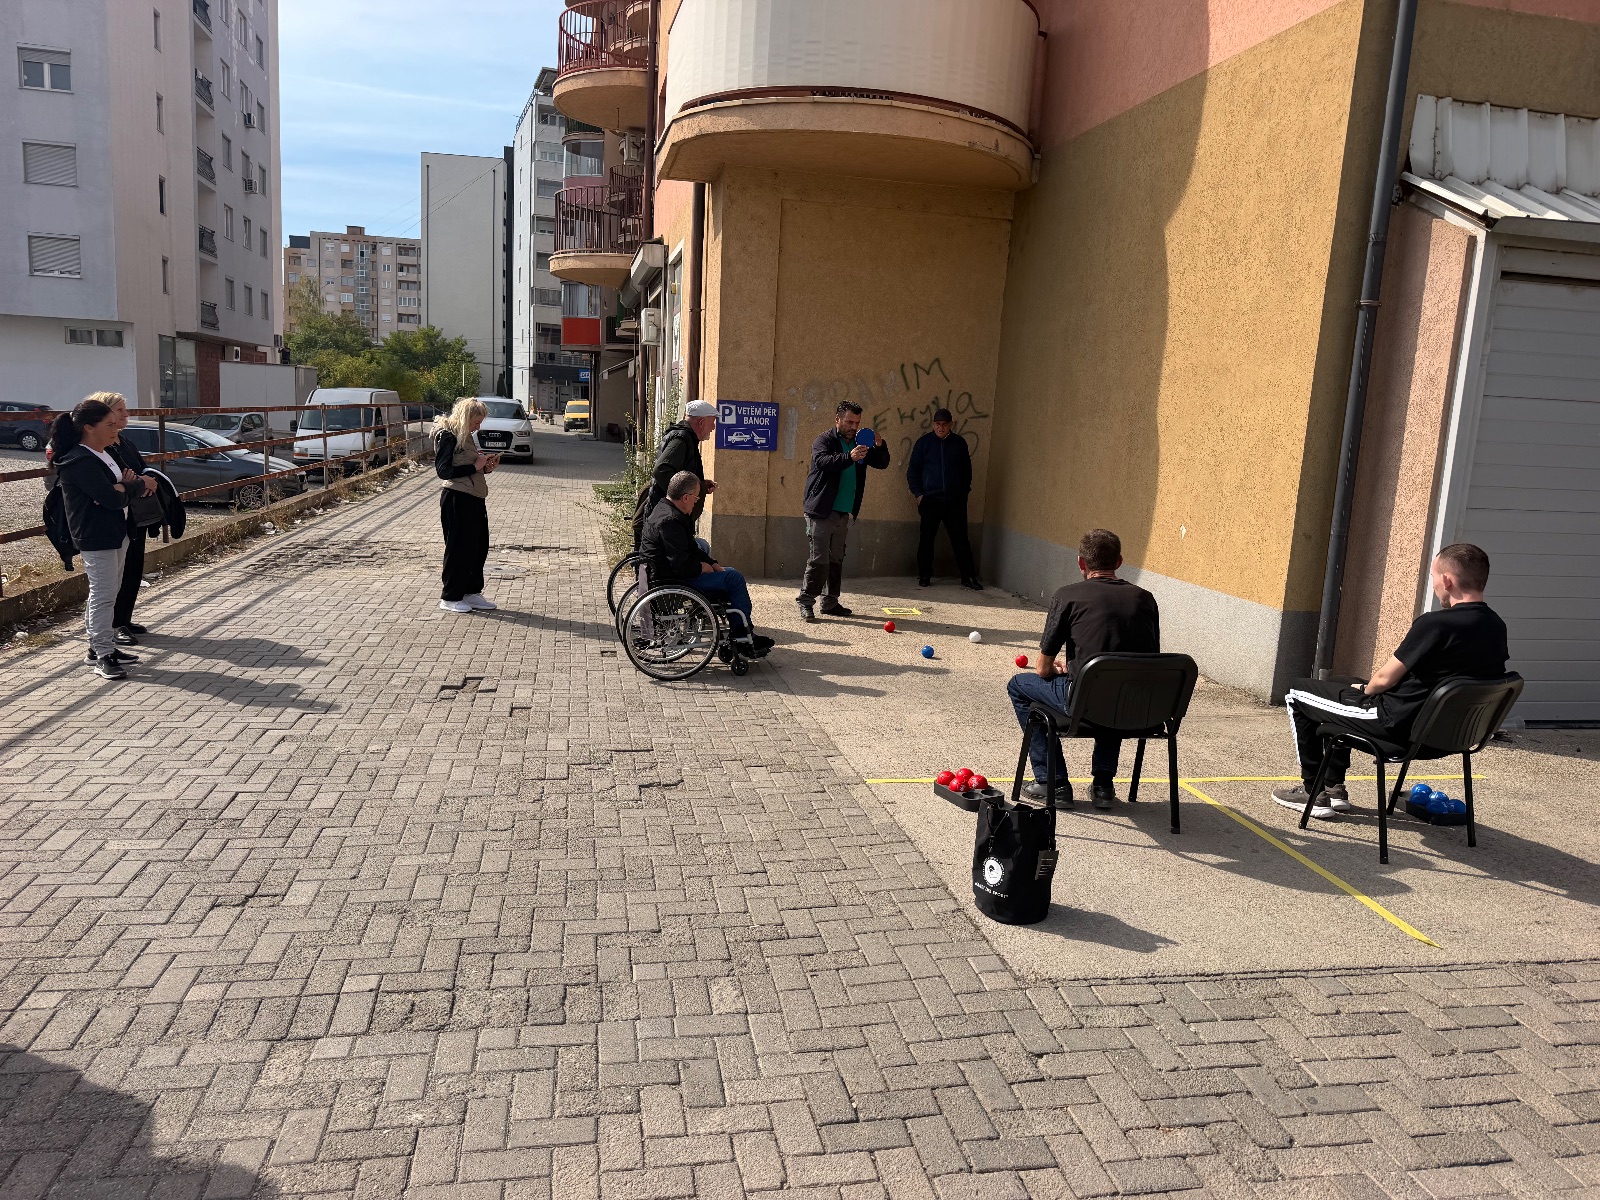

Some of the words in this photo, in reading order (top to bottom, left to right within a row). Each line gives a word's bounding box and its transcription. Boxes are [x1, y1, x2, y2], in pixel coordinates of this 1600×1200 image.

[737, 405, 761, 416] VETËM
[763, 407, 777, 416] PËR
[743, 416, 770, 426] BANOR
